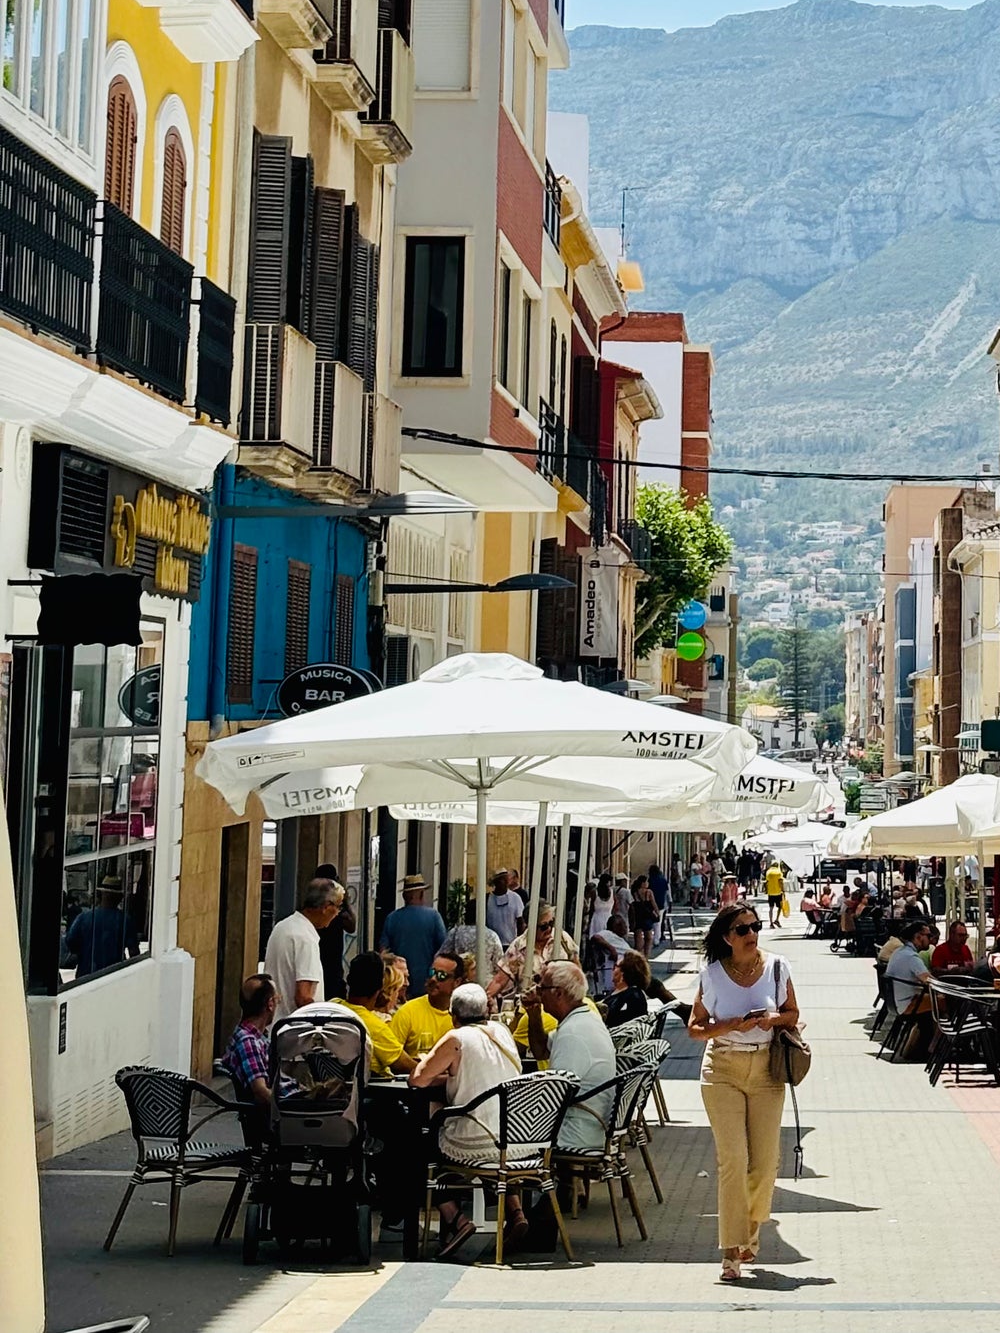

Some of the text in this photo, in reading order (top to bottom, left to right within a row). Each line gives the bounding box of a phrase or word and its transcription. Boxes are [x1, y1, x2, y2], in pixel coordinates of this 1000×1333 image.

[584, 580, 596, 648] Amadeo
[300, 669, 352, 685] MUSICA
[305, 689, 345, 702] BAR
